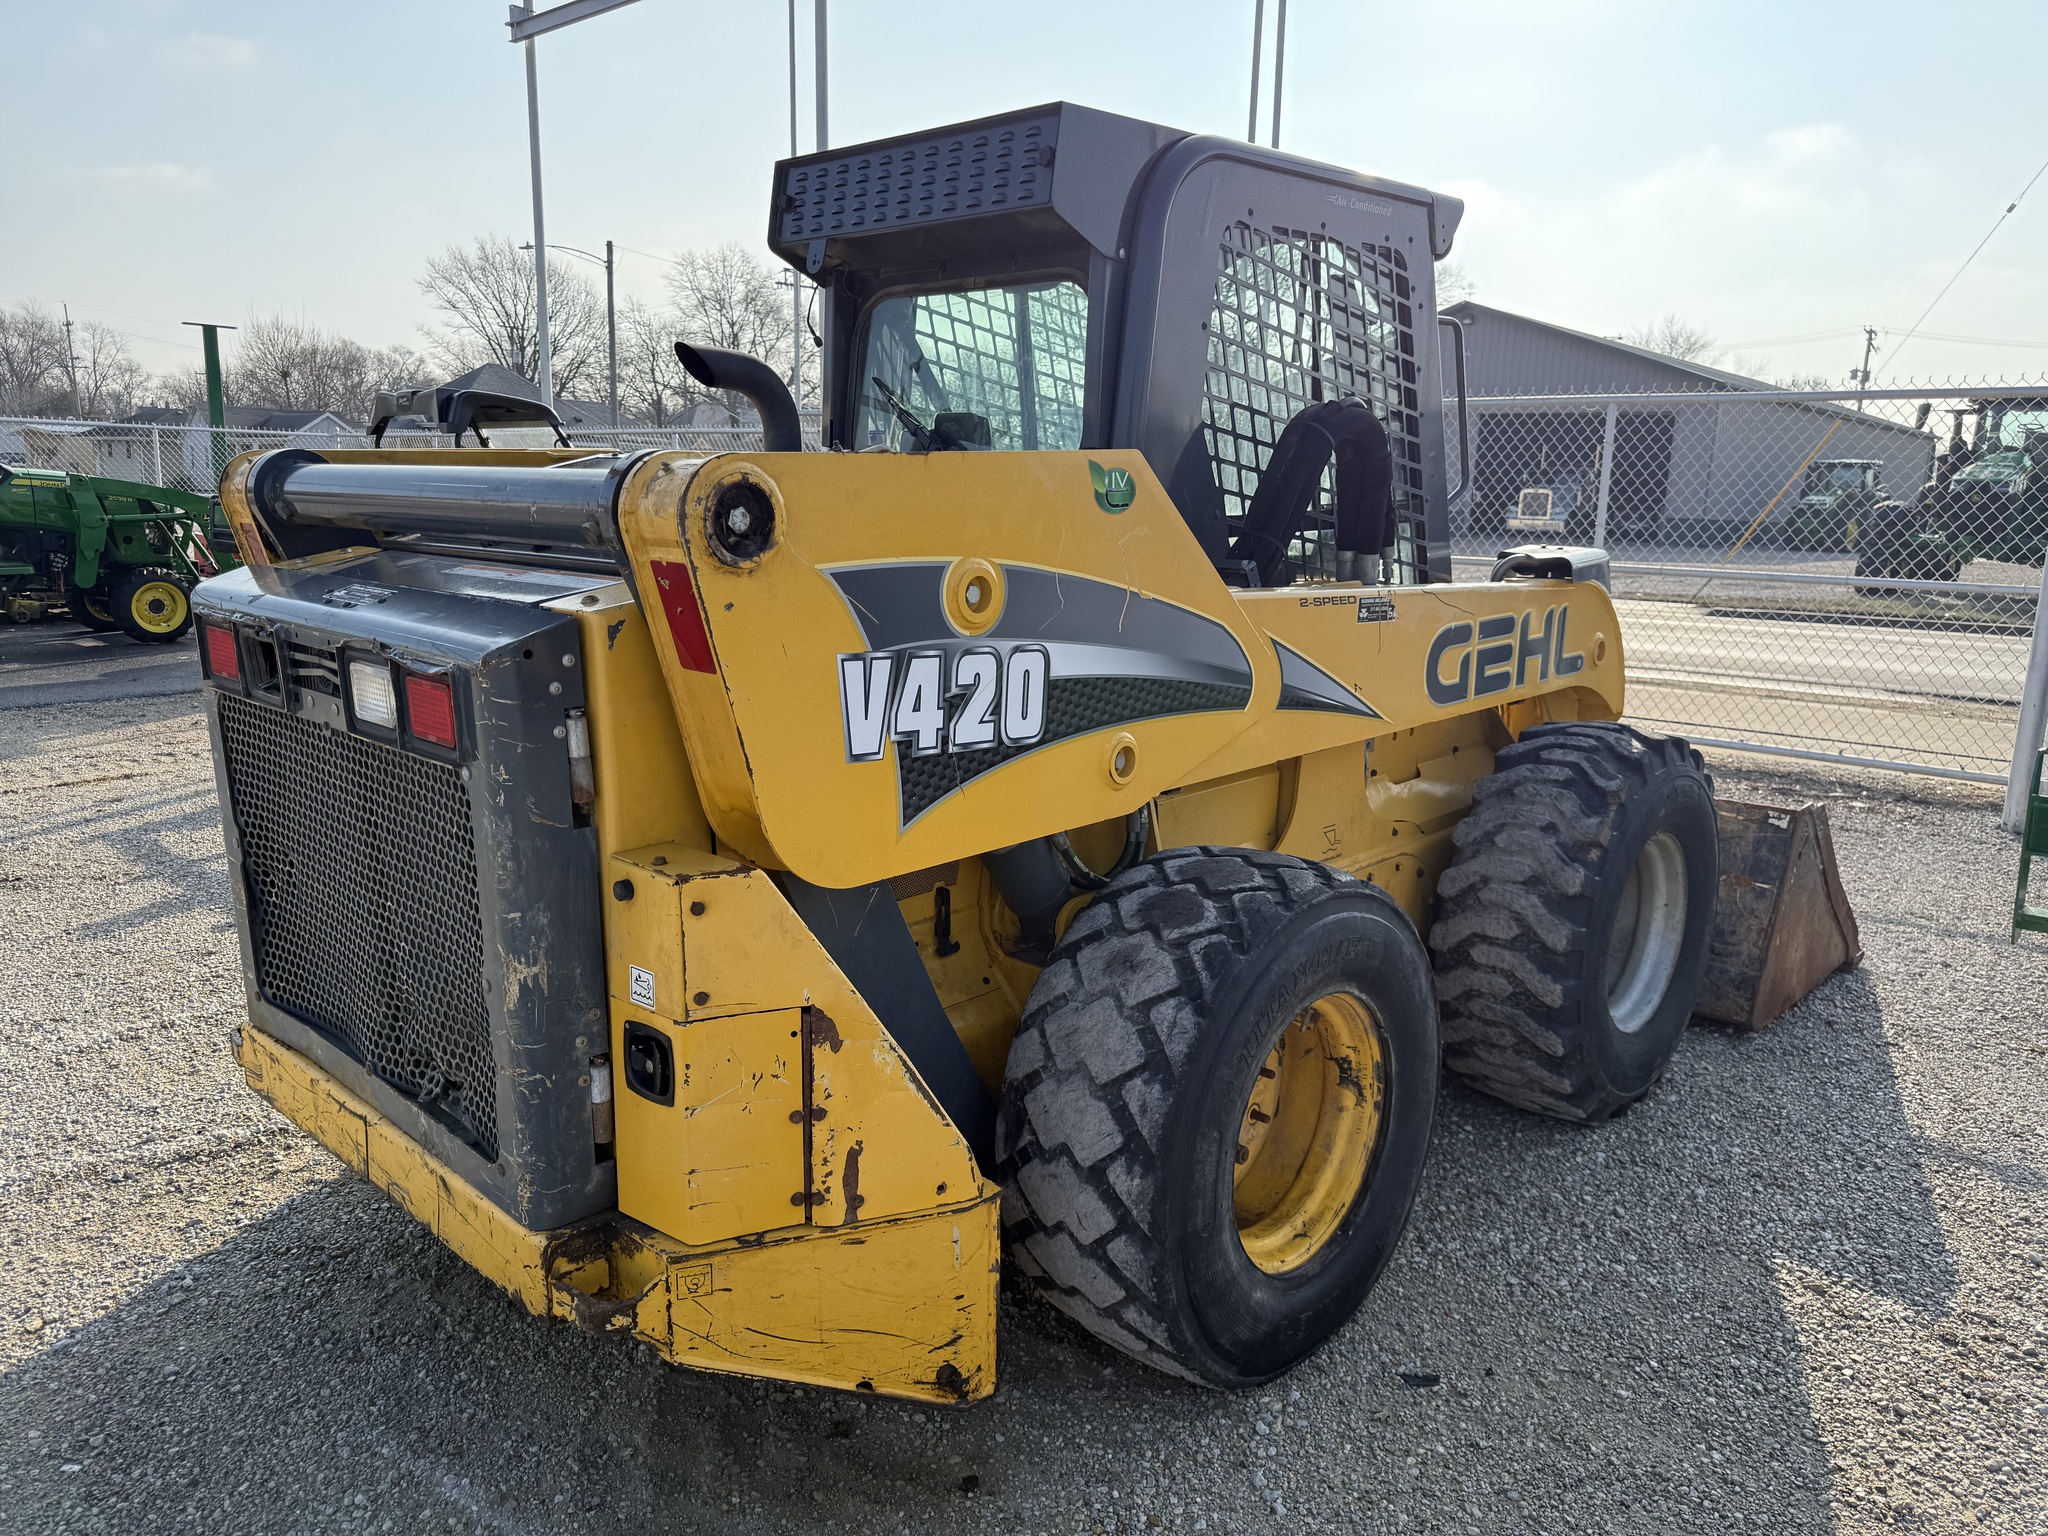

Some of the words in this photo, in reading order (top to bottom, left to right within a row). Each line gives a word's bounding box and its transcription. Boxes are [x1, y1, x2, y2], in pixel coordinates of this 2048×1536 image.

[1336, 194, 1393, 217] Air-Conditioned
[1112, 472, 1129, 489] IV
[1299, 595, 1357, 607] 2-SPEED
[1425, 603, 1584, 706] GEHL
[837, 644, 1050, 764] V420
